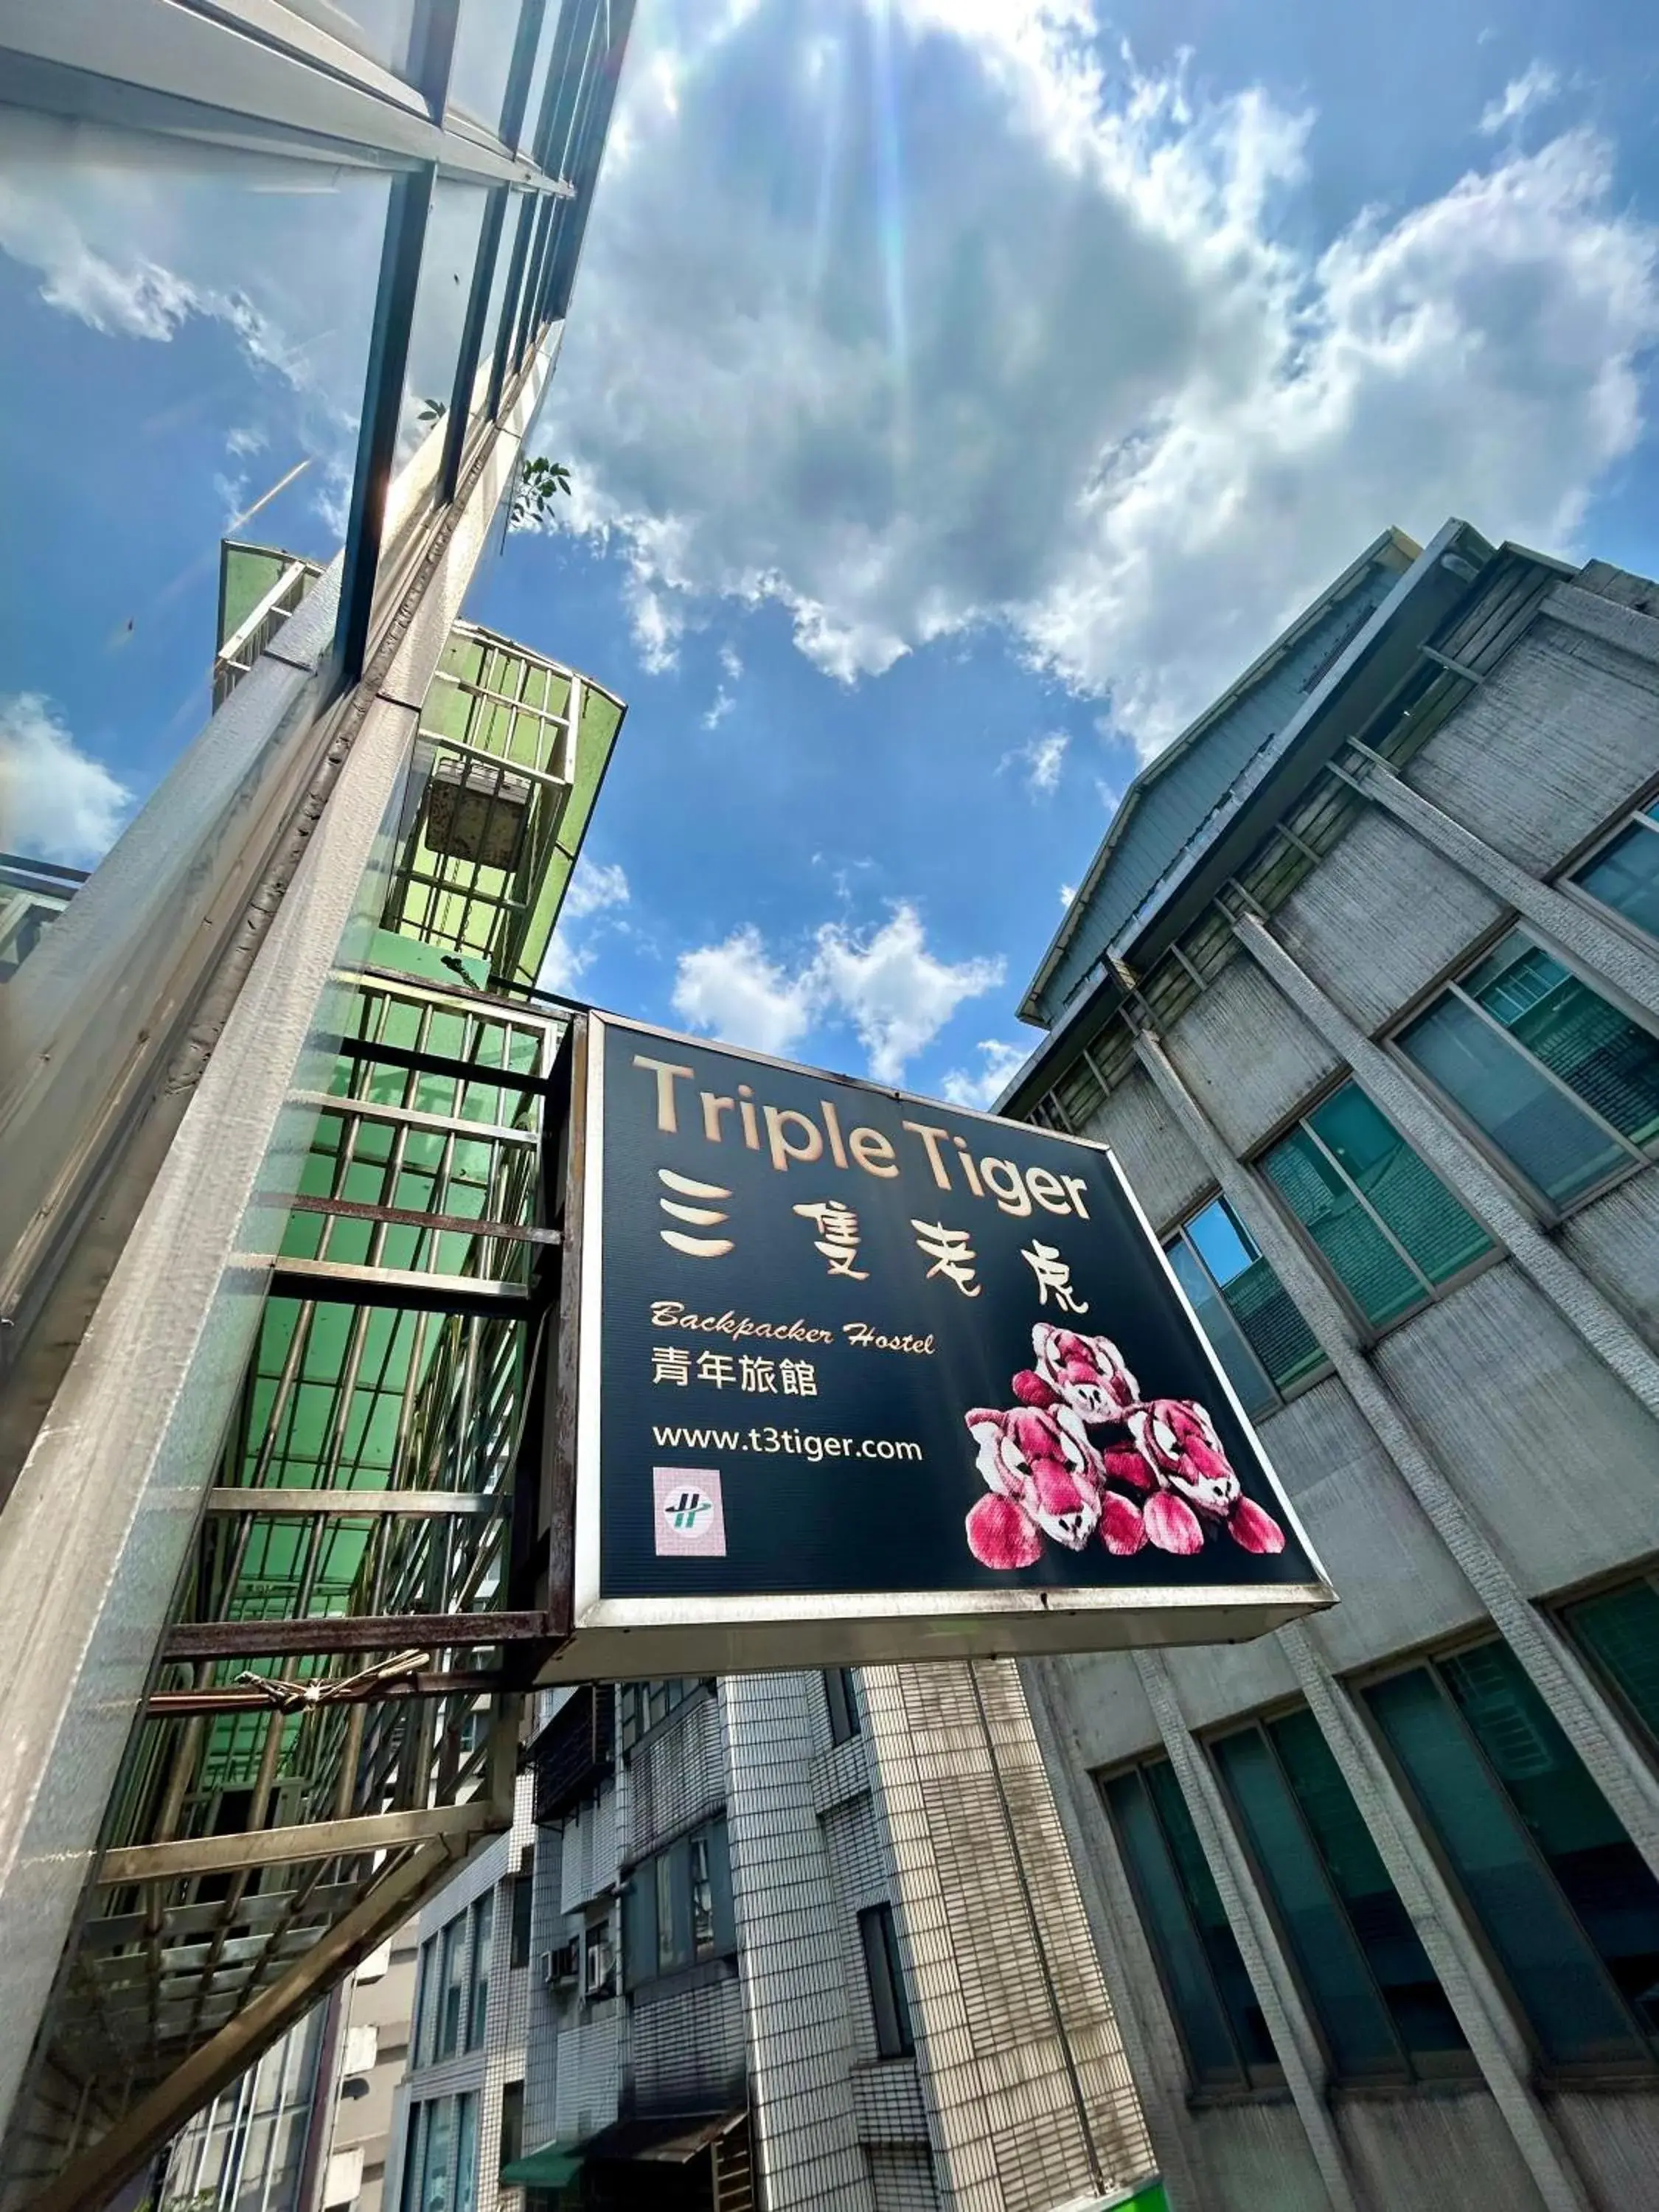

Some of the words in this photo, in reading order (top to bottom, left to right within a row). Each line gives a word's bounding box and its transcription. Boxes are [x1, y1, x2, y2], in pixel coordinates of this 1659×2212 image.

[633, 1055, 900, 1178] Triple
[902, 1119, 1091, 1220] Tiger
[650, 1301, 835, 1345] Backpacker
[843, 1322, 936, 1355] Hostel
[651, 1346, 818, 1396] 青年旅館
[653, 1425, 923, 1461] www.t3tiger.com
